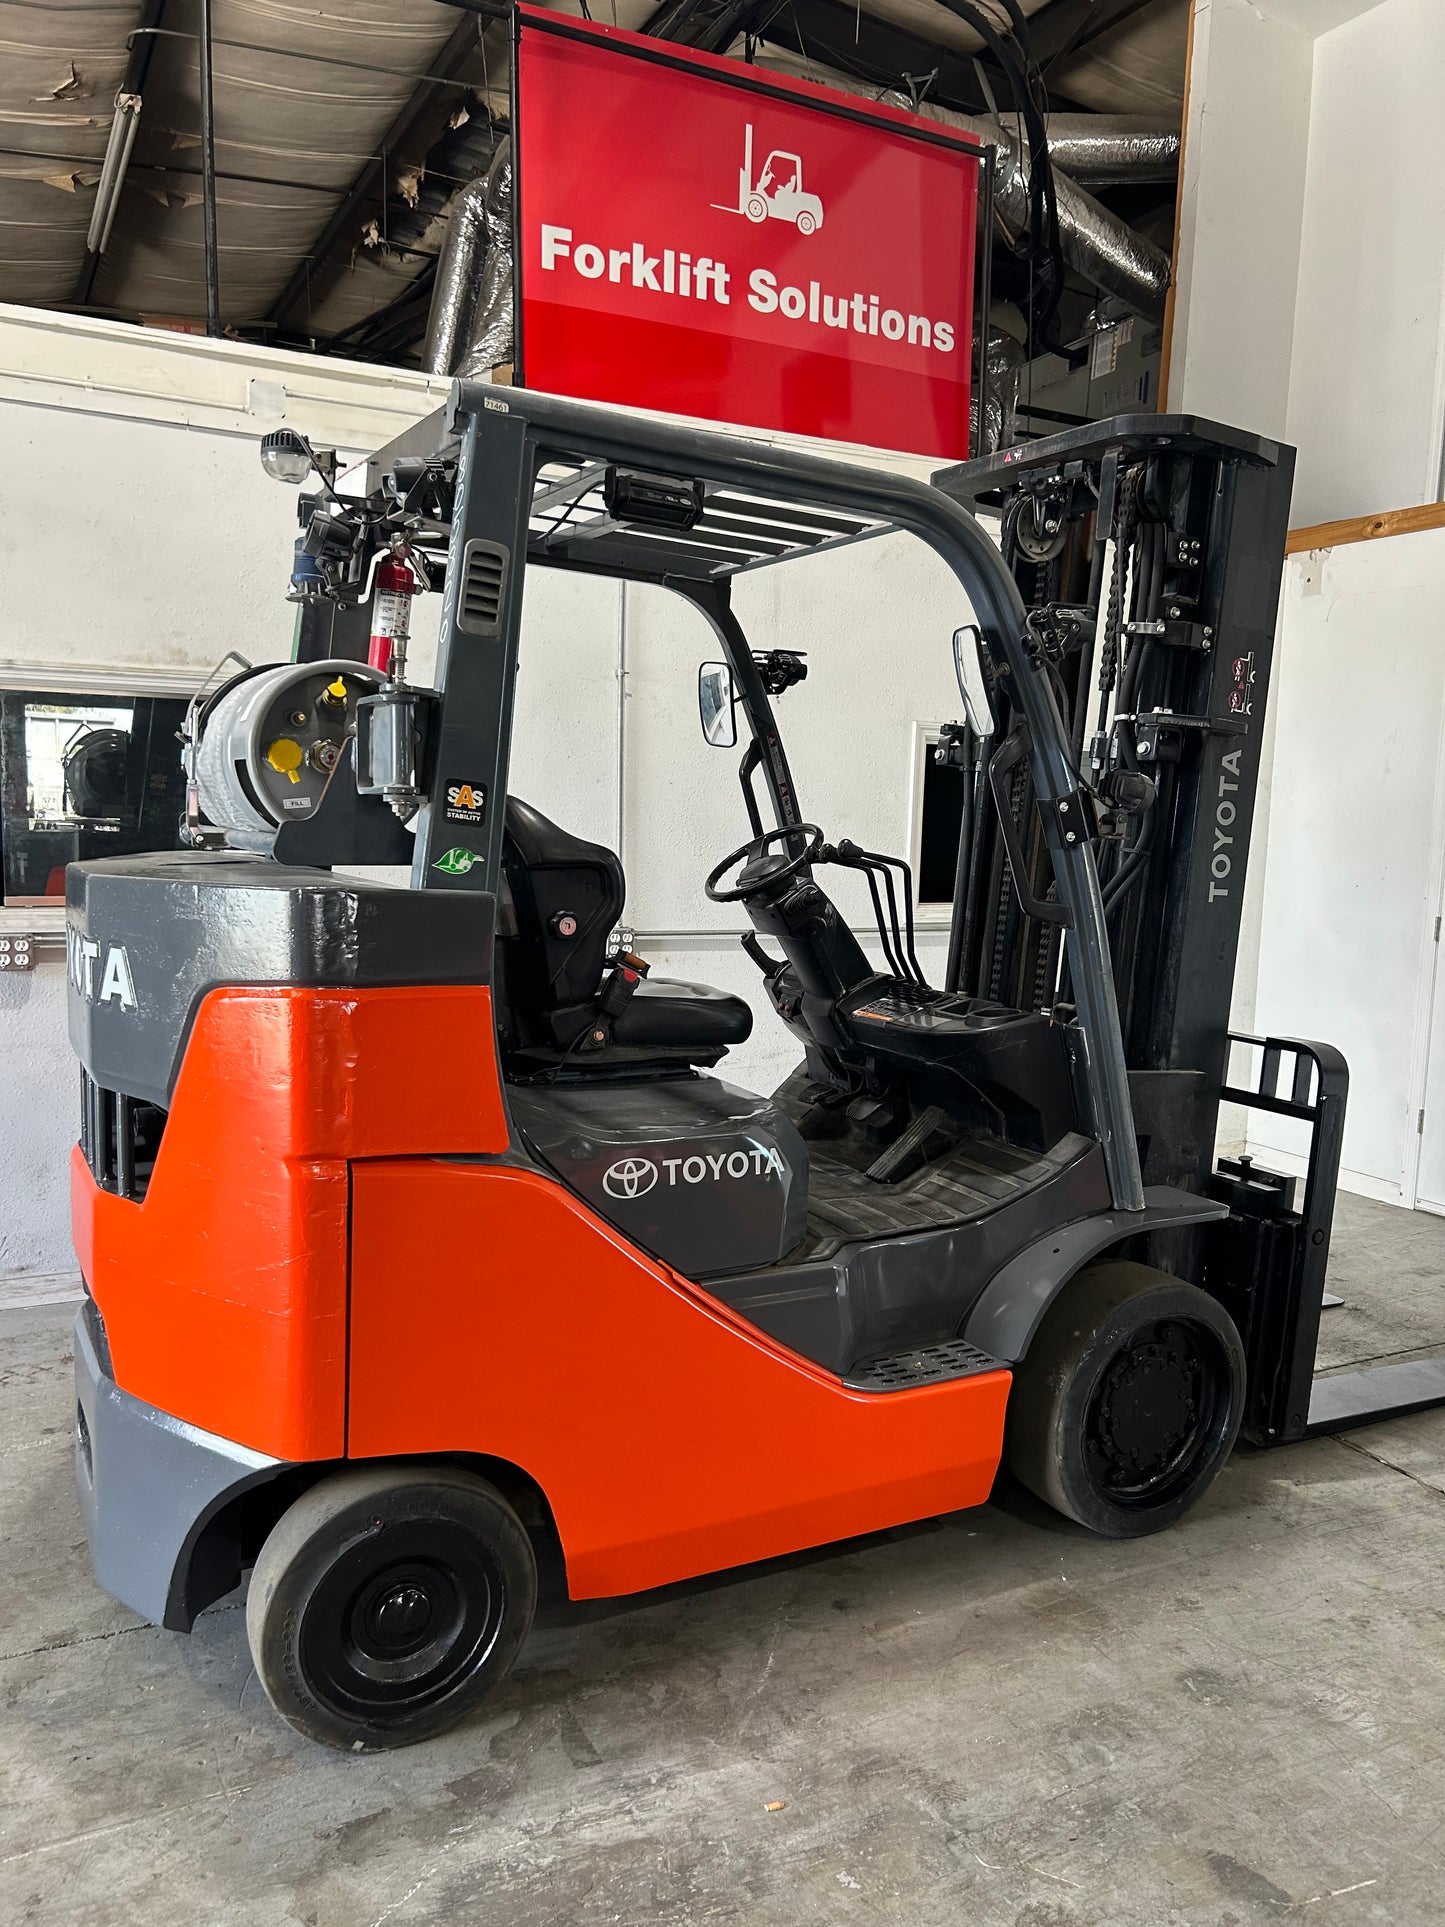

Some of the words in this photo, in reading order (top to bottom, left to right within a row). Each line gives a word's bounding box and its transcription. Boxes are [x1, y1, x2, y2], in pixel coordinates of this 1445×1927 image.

[541, 224, 731, 305] Forklift
[747, 268, 956, 352] Solutions
[447, 784, 484, 809] SAS
[446, 811, 481, 822] STABILITY
[1208, 749, 1242, 903] TOYOTA
[662, 1147, 786, 1186] TOYOTA
